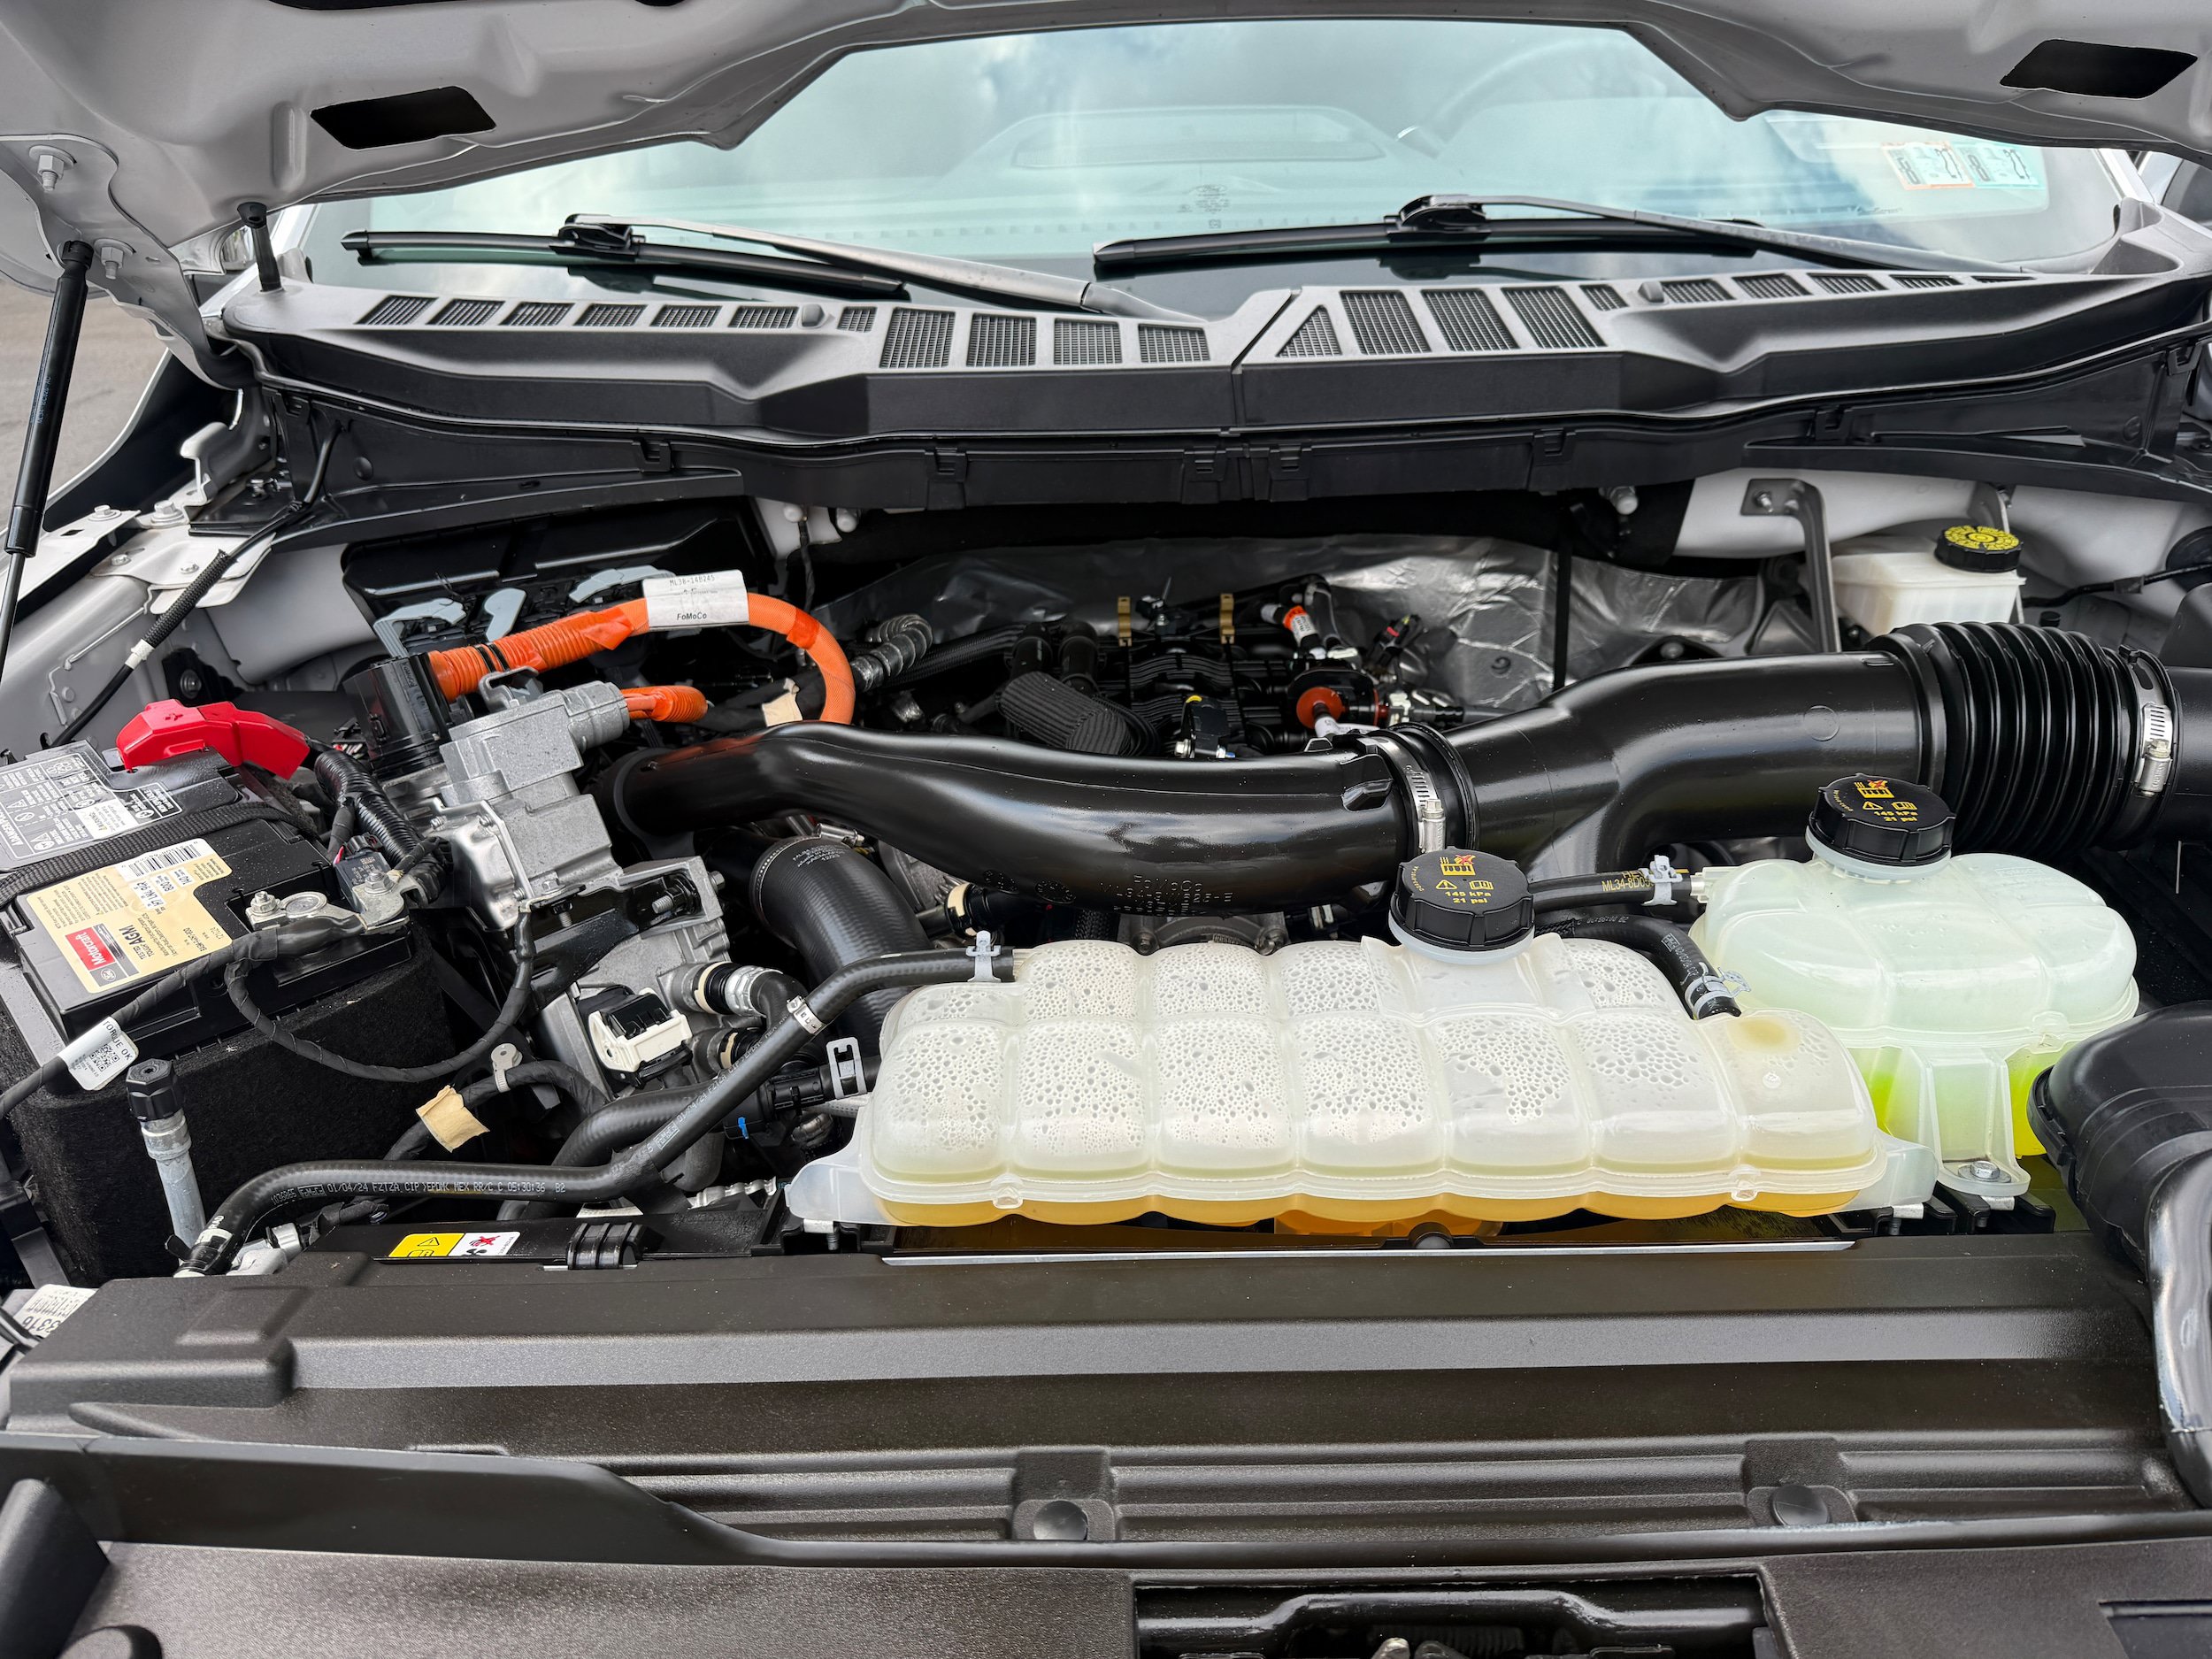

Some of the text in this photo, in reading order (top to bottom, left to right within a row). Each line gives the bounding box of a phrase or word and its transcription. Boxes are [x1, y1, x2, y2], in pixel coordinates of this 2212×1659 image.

[73, 931, 106, 965] Motorcraft
[118, 924, 145, 947] AGM
[102, 1020, 134, 1062] TORQUE OK
[327, 1183, 368, 1193] 01/04/24
[404, 1182, 419, 1191] CIP
[508, 1182, 546, 1193] 05:30:36
[556, 1183, 565, 1193] B2
